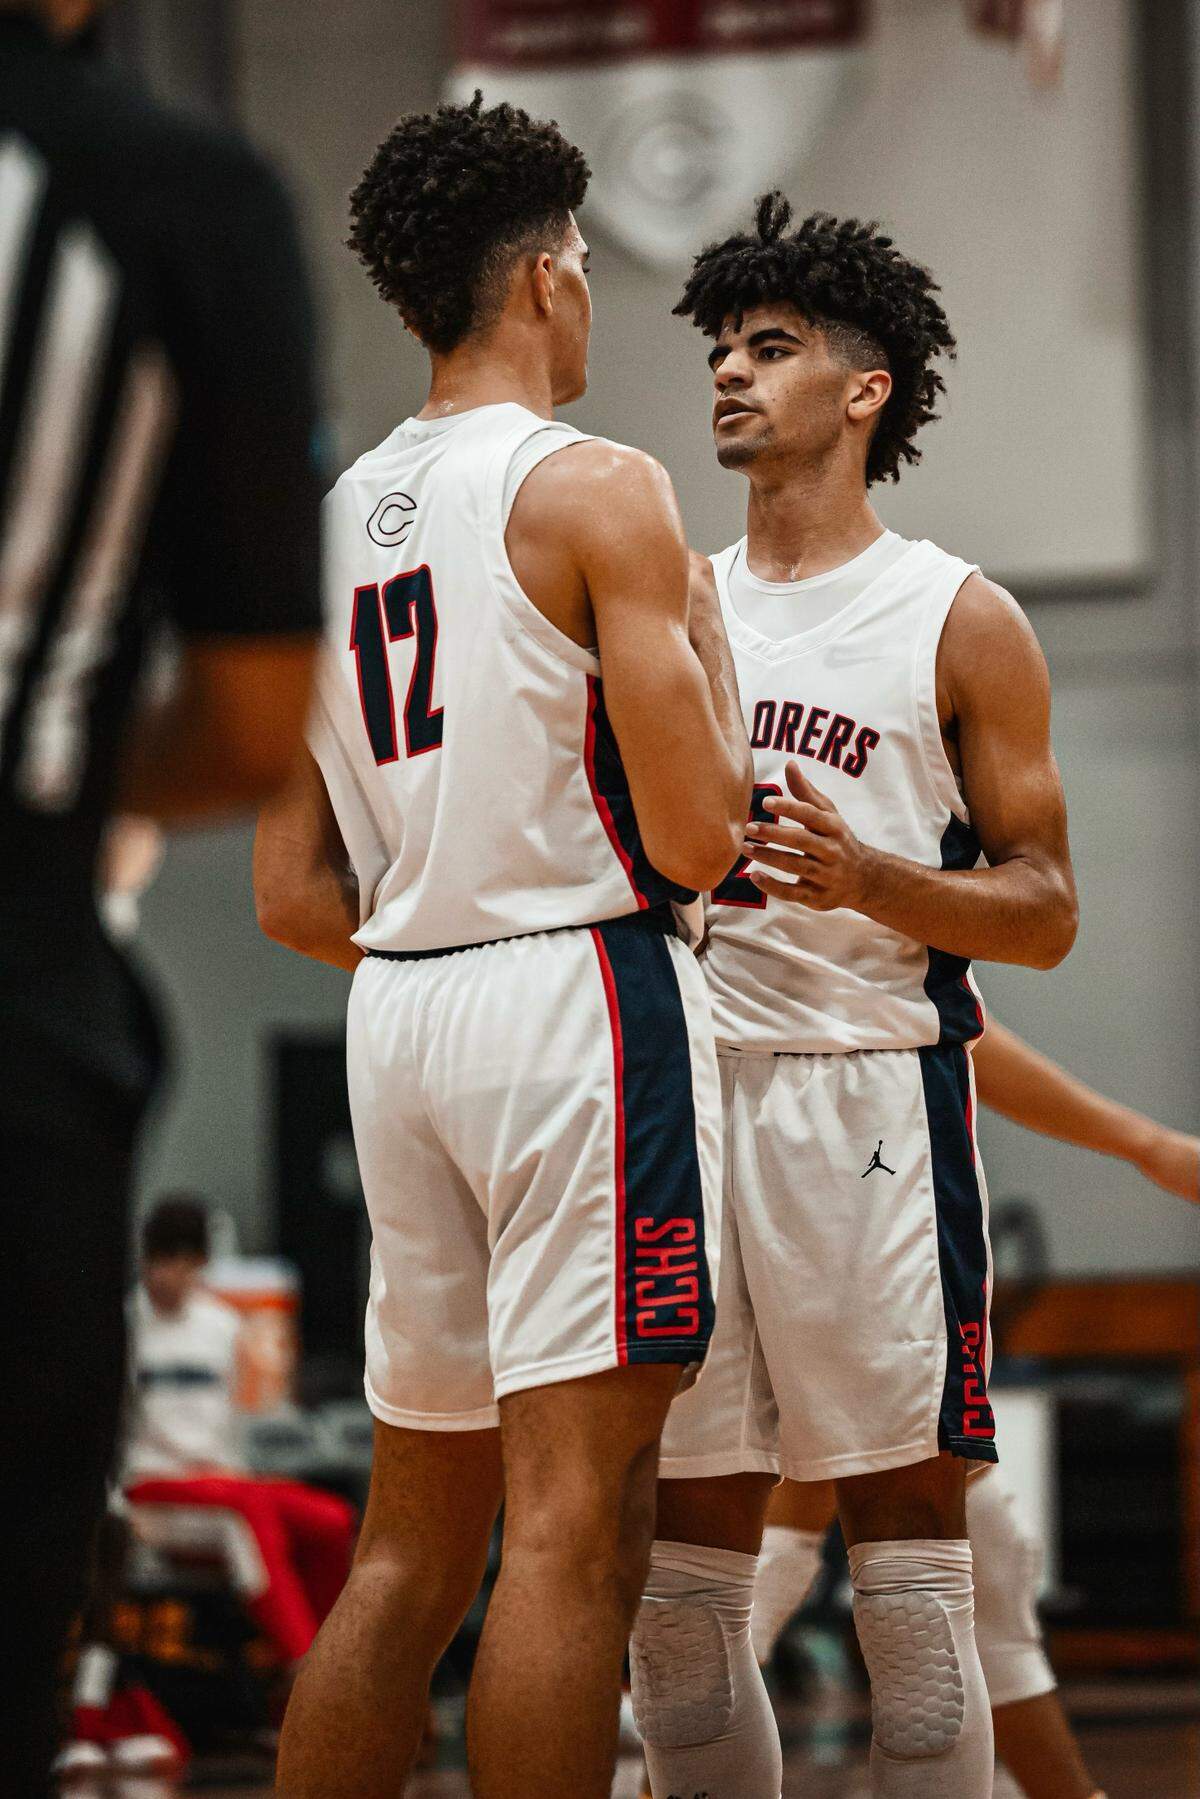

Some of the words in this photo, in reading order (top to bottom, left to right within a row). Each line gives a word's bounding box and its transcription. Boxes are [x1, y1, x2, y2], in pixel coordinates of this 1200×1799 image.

[366, 491, 417, 547] C
[349, 563, 444, 767] 12
[634, 1217, 699, 1338] CCHS
